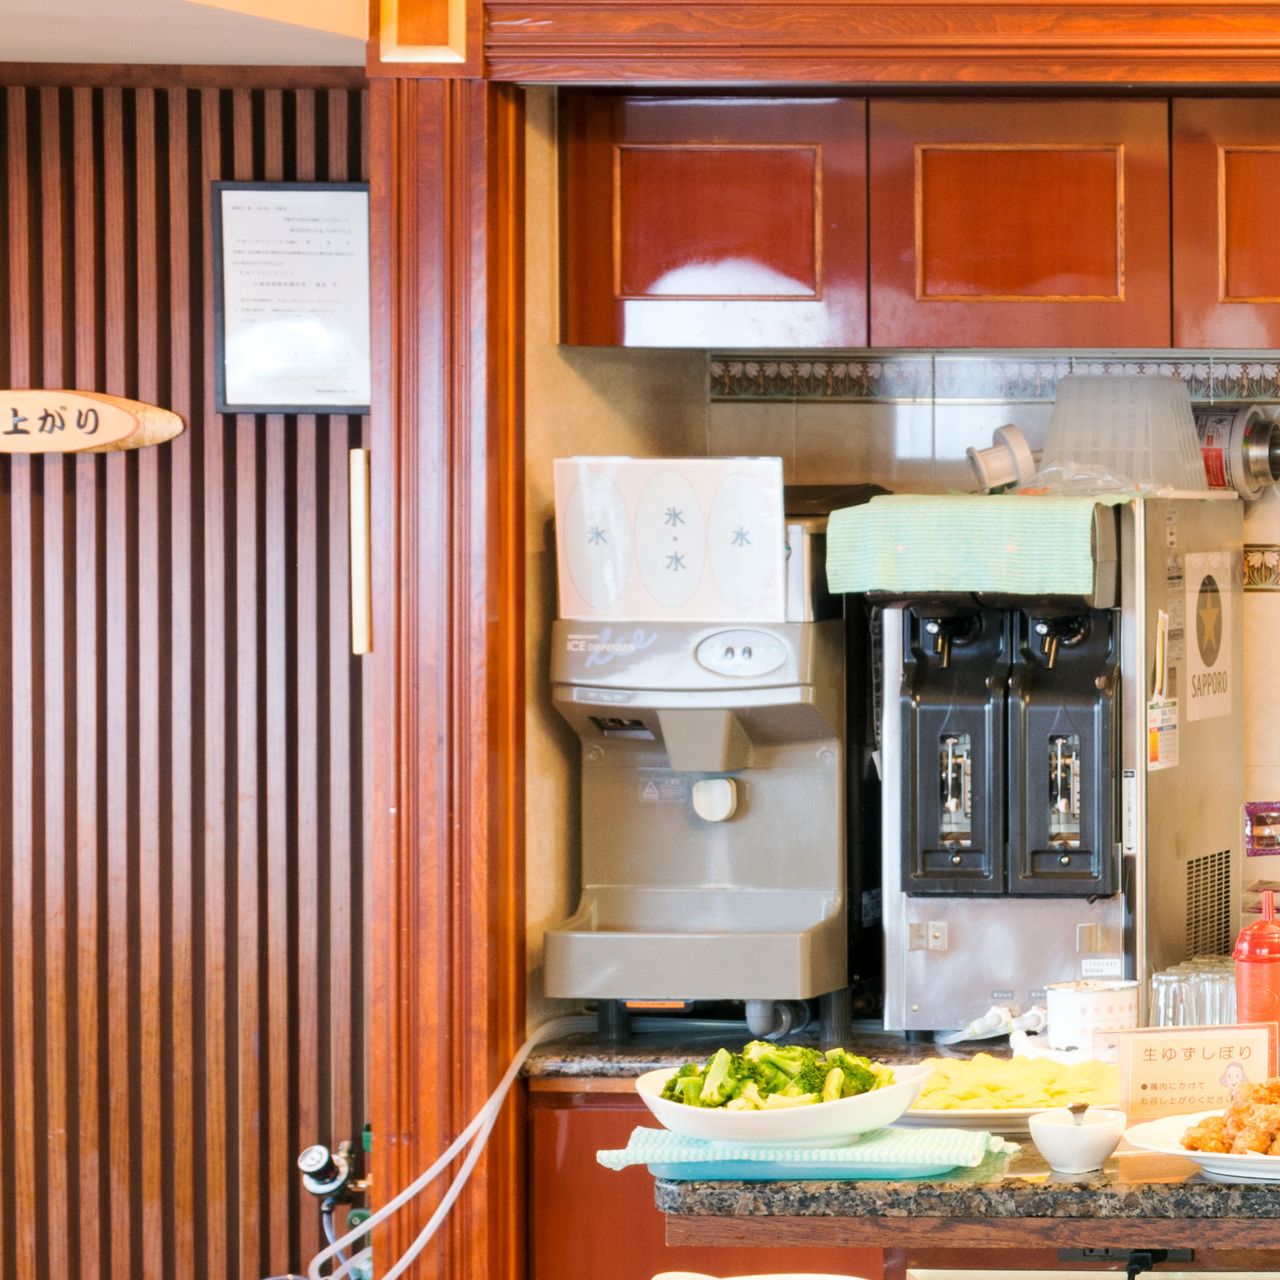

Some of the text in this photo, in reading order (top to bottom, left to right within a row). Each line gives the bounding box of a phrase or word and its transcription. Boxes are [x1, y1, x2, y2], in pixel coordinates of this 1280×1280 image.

[3, 404, 99, 435] 上がり
[587, 525, 608, 546] 氷
[731, 527, 752, 547] 水
[566, 640, 587, 652] ICE
[1191, 670, 1228, 698] SAPPORO
[1142, 1045, 1252, 1062] 生ゆずしぼり
